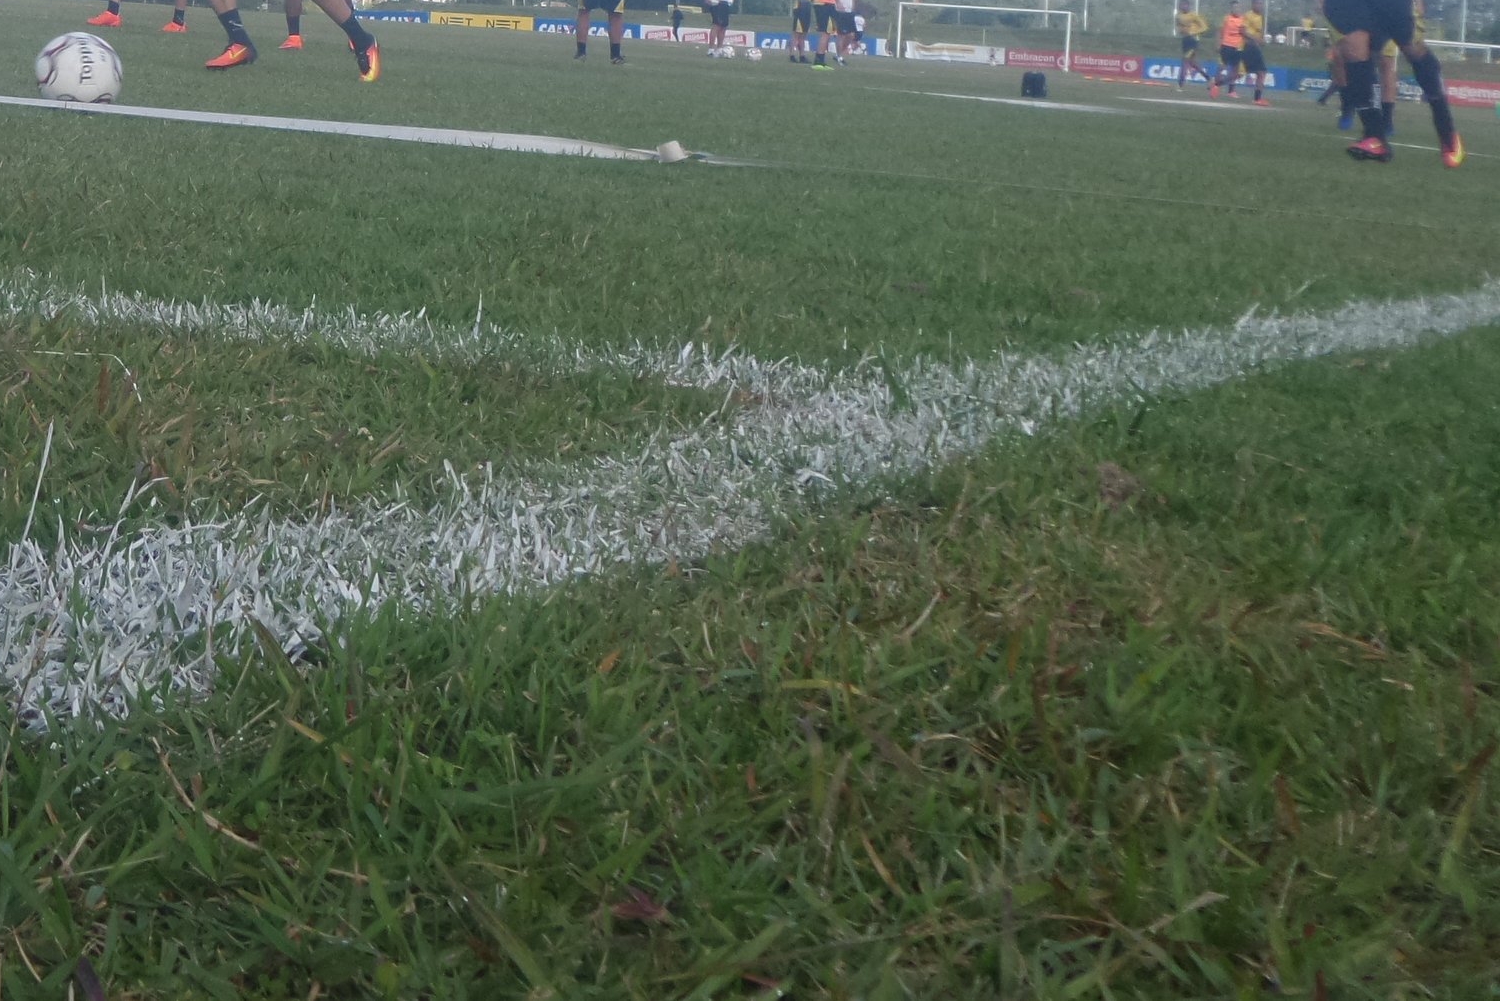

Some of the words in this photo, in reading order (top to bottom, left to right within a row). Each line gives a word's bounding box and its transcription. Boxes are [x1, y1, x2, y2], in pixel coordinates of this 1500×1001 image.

[439, 16, 474, 27] NET
[485, 19, 521, 30] NET
[1008, 51, 1056, 63] Embracon
[1074, 55, 1121, 67] Embracon
